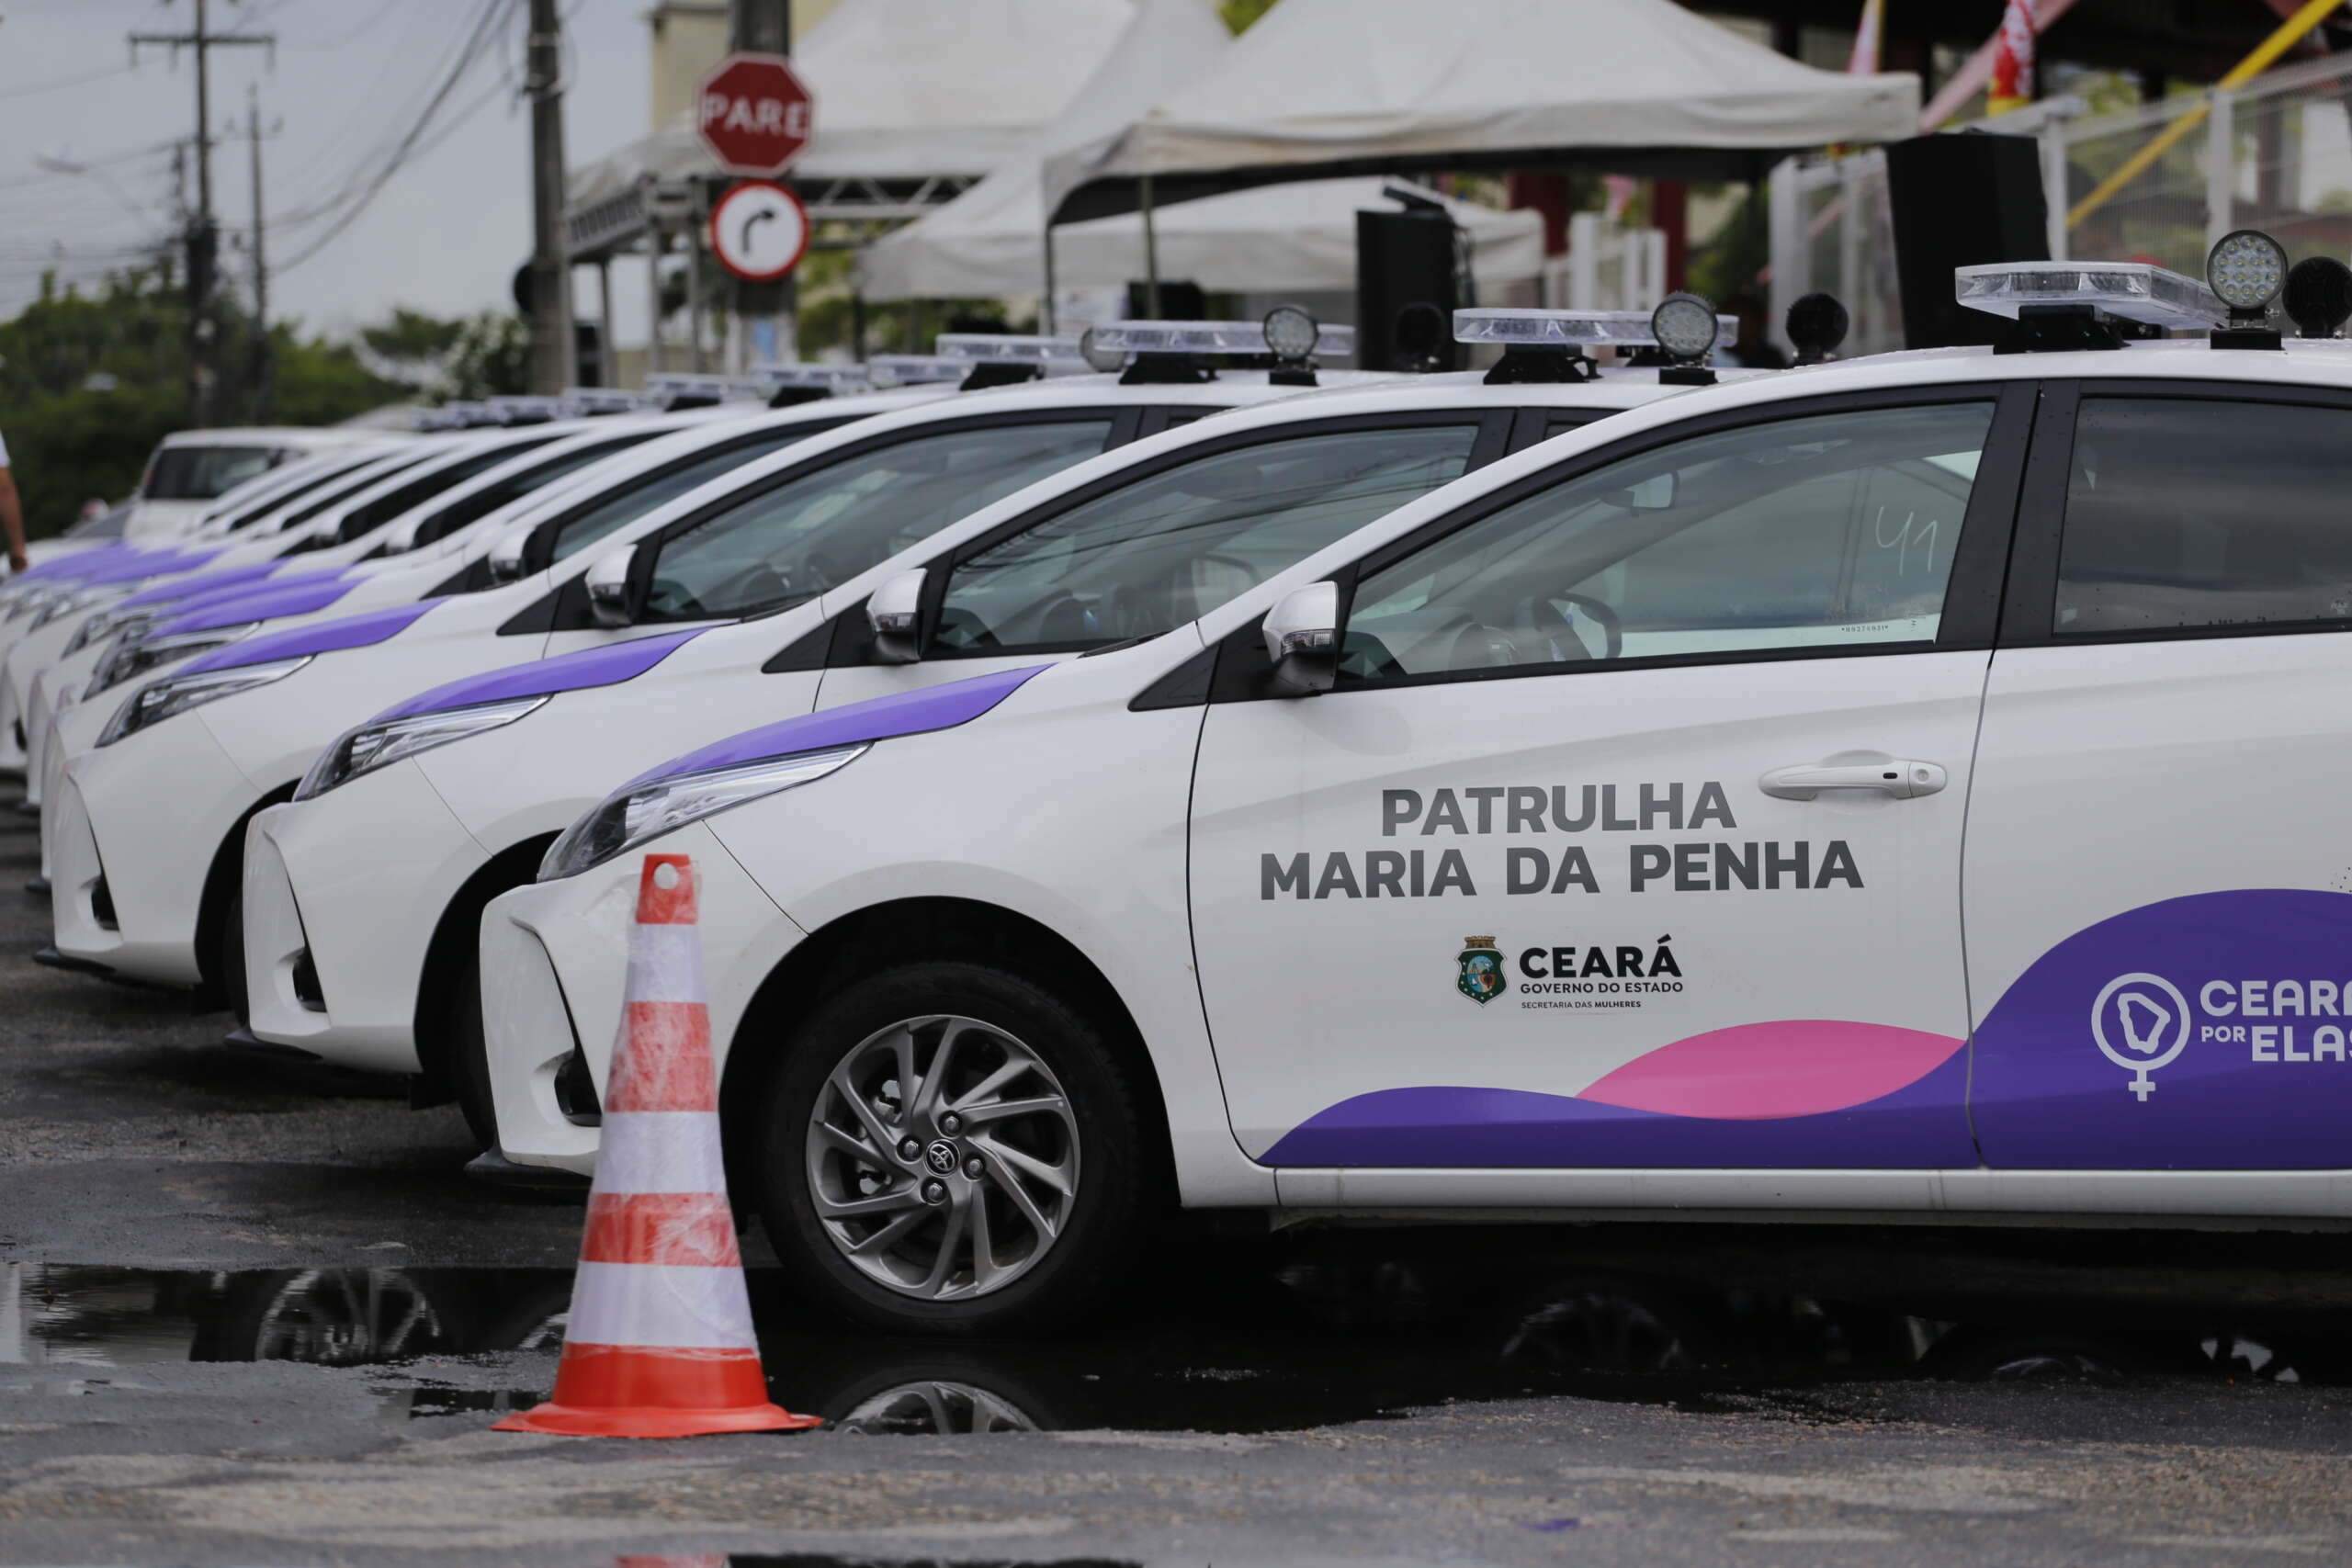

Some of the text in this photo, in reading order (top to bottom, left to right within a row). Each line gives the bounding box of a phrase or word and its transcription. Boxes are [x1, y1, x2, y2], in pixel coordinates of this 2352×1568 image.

[701, 93, 808, 138] PARE
[1382, 781, 1738, 837] PATRULHA
[1261, 840, 1865, 900] MARIA DA PENHA
[1519, 933, 1683, 979] CEARÁ
[1520, 981, 1683, 994] GOVERNO DO ESTADO
[1575, 1000, 1592, 1009] DAS
[1594, 999, 1641, 1008] MULHERES
[2201, 1025, 2352, 1062] POR ELA
